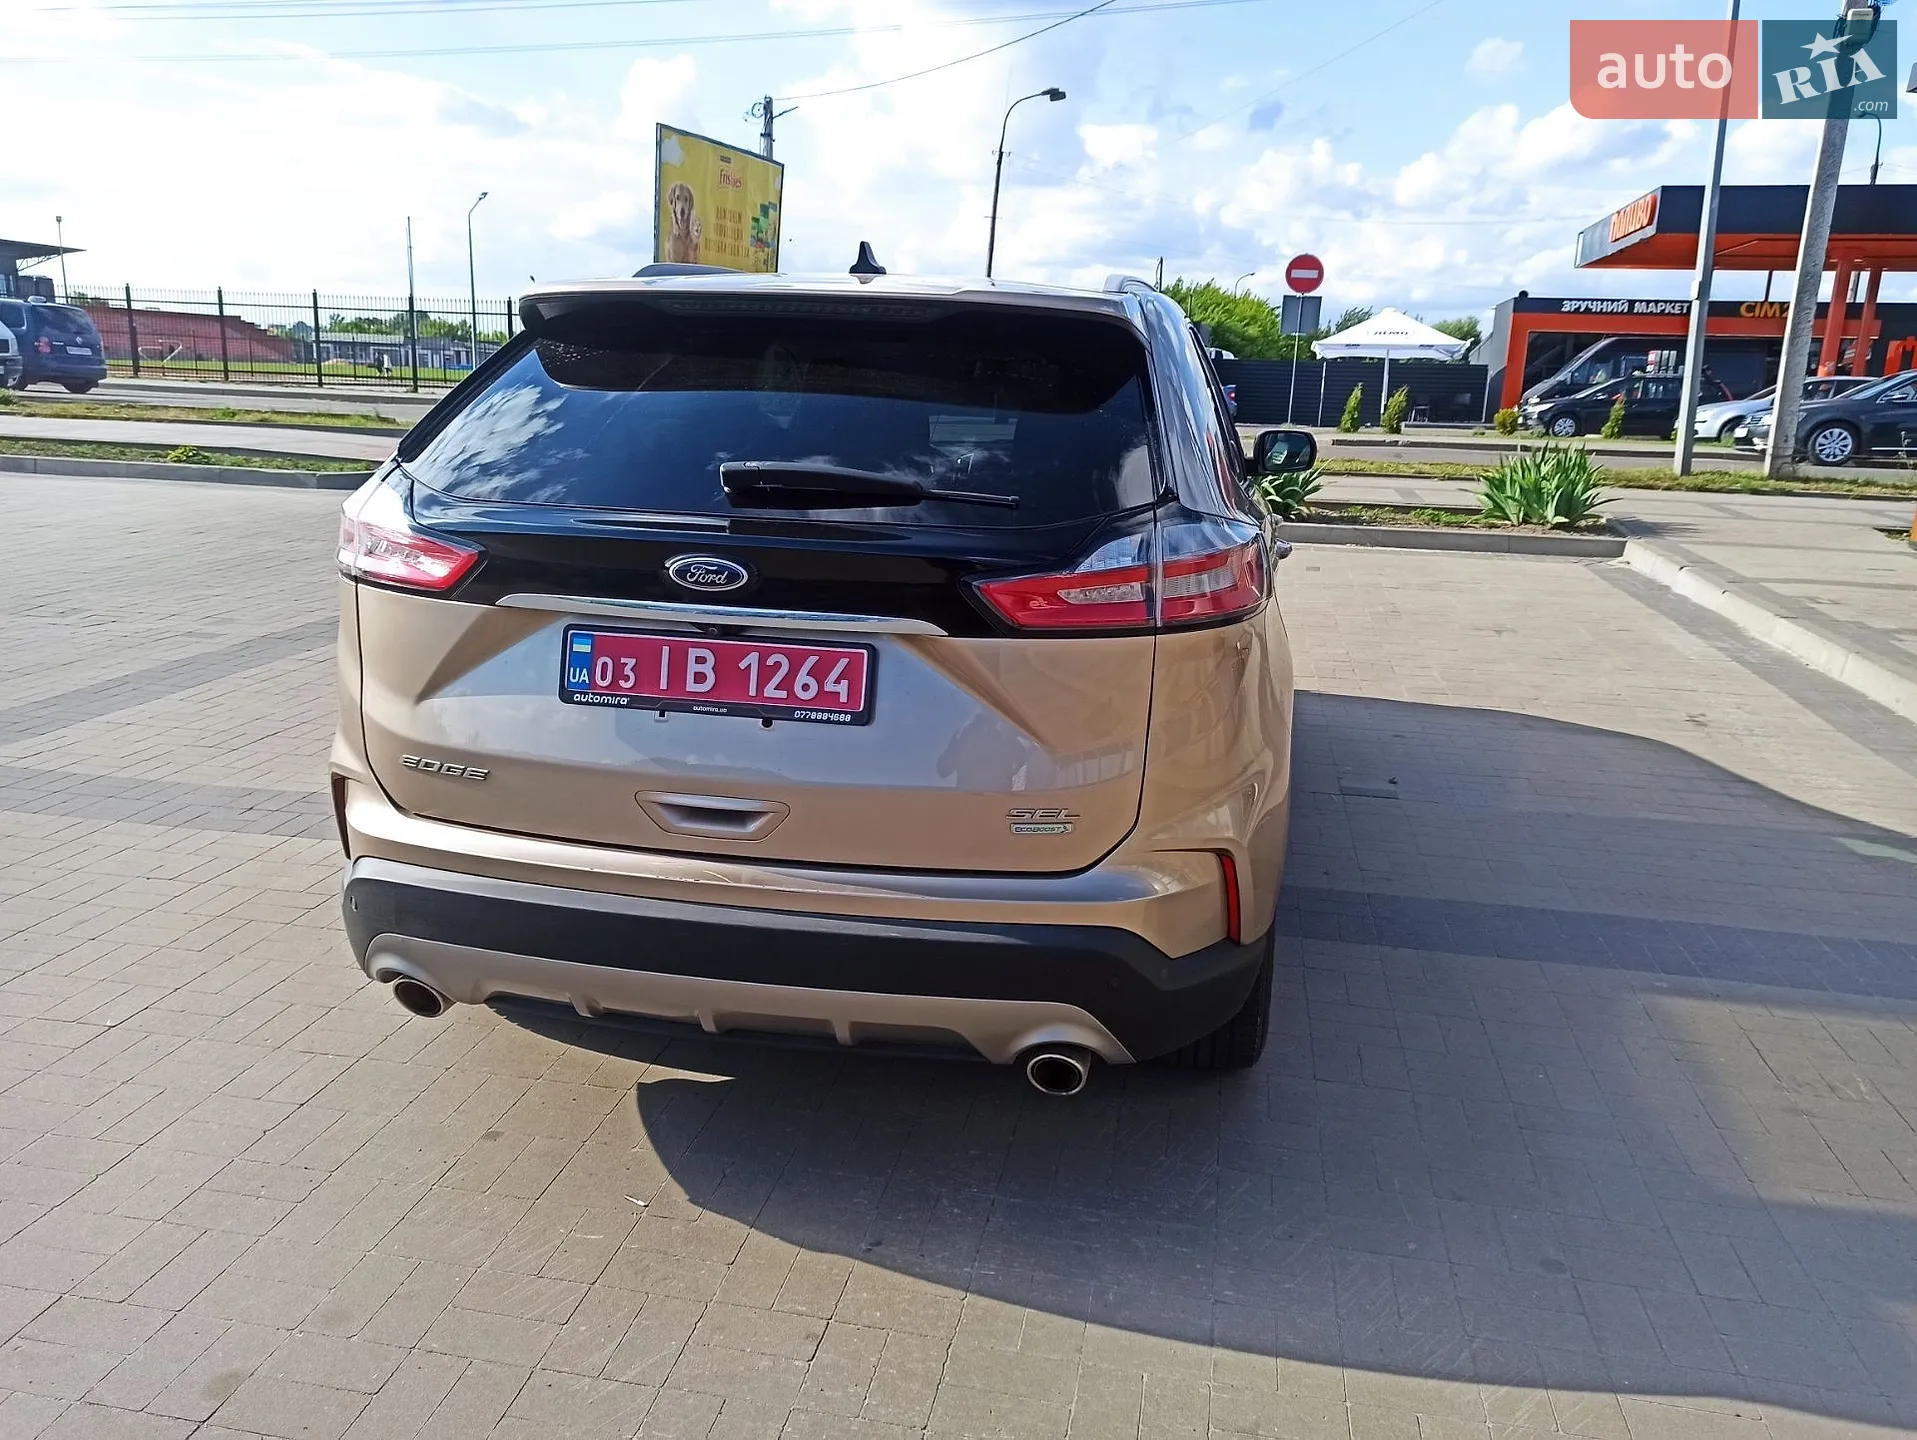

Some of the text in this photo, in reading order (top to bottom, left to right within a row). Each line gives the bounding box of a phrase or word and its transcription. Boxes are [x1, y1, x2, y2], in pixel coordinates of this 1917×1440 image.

[1561, 299, 1690, 314] ЗРУЧНИЙ МАРКЕТ
[686, 564, 728, 584] Ford
[569, 669, 589, 684] UA
[595, 645, 850, 703] 03 IB 1264
[573, 693, 628, 705] automira
[401, 754, 491, 780] EDGE
[1005, 808, 1082, 819] SEL
